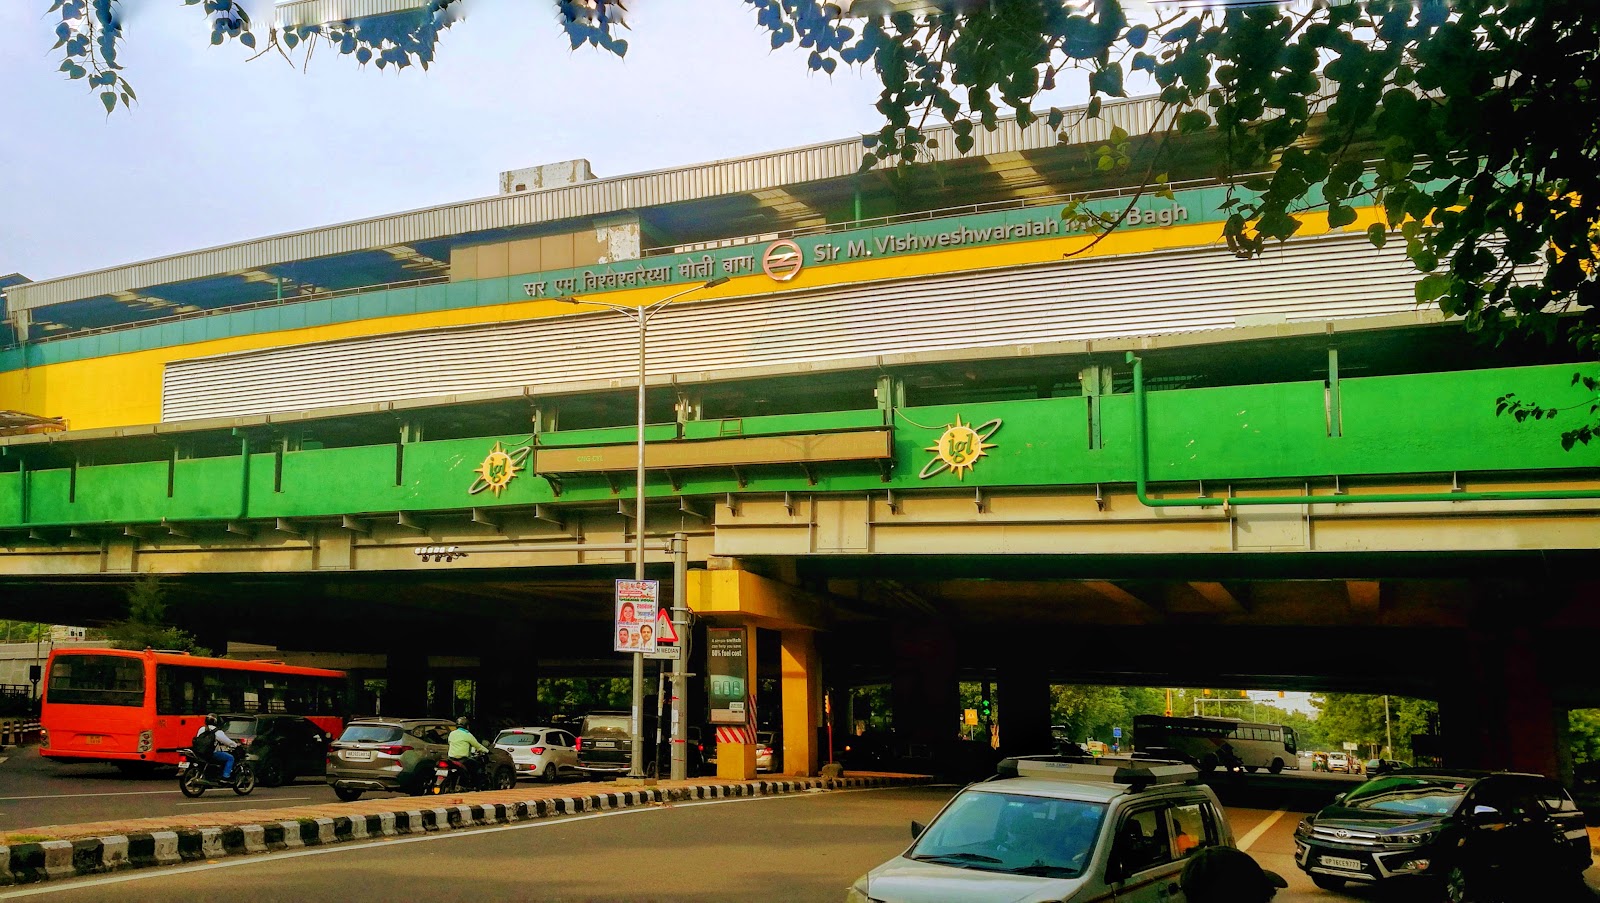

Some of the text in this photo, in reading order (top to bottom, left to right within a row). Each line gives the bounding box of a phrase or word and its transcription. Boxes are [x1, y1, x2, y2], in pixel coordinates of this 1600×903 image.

[813, 243, 840, 263] Sir
[847, 240, 872, 258] M.
[875, 217, 1059, 254] Vishweshwaraiah
[1127, 203, 1188, 226] Bagh
[523, 281, 547, 297] सर
[678, 254, 716, 279] मोती
[722, 255, 754, 274] बाग
[948, 433, 974, 463] igl
[489, 457, 507, 483] igl
[721, 649, 731, 657] fuel
[731, 649, 742, 657] cost
